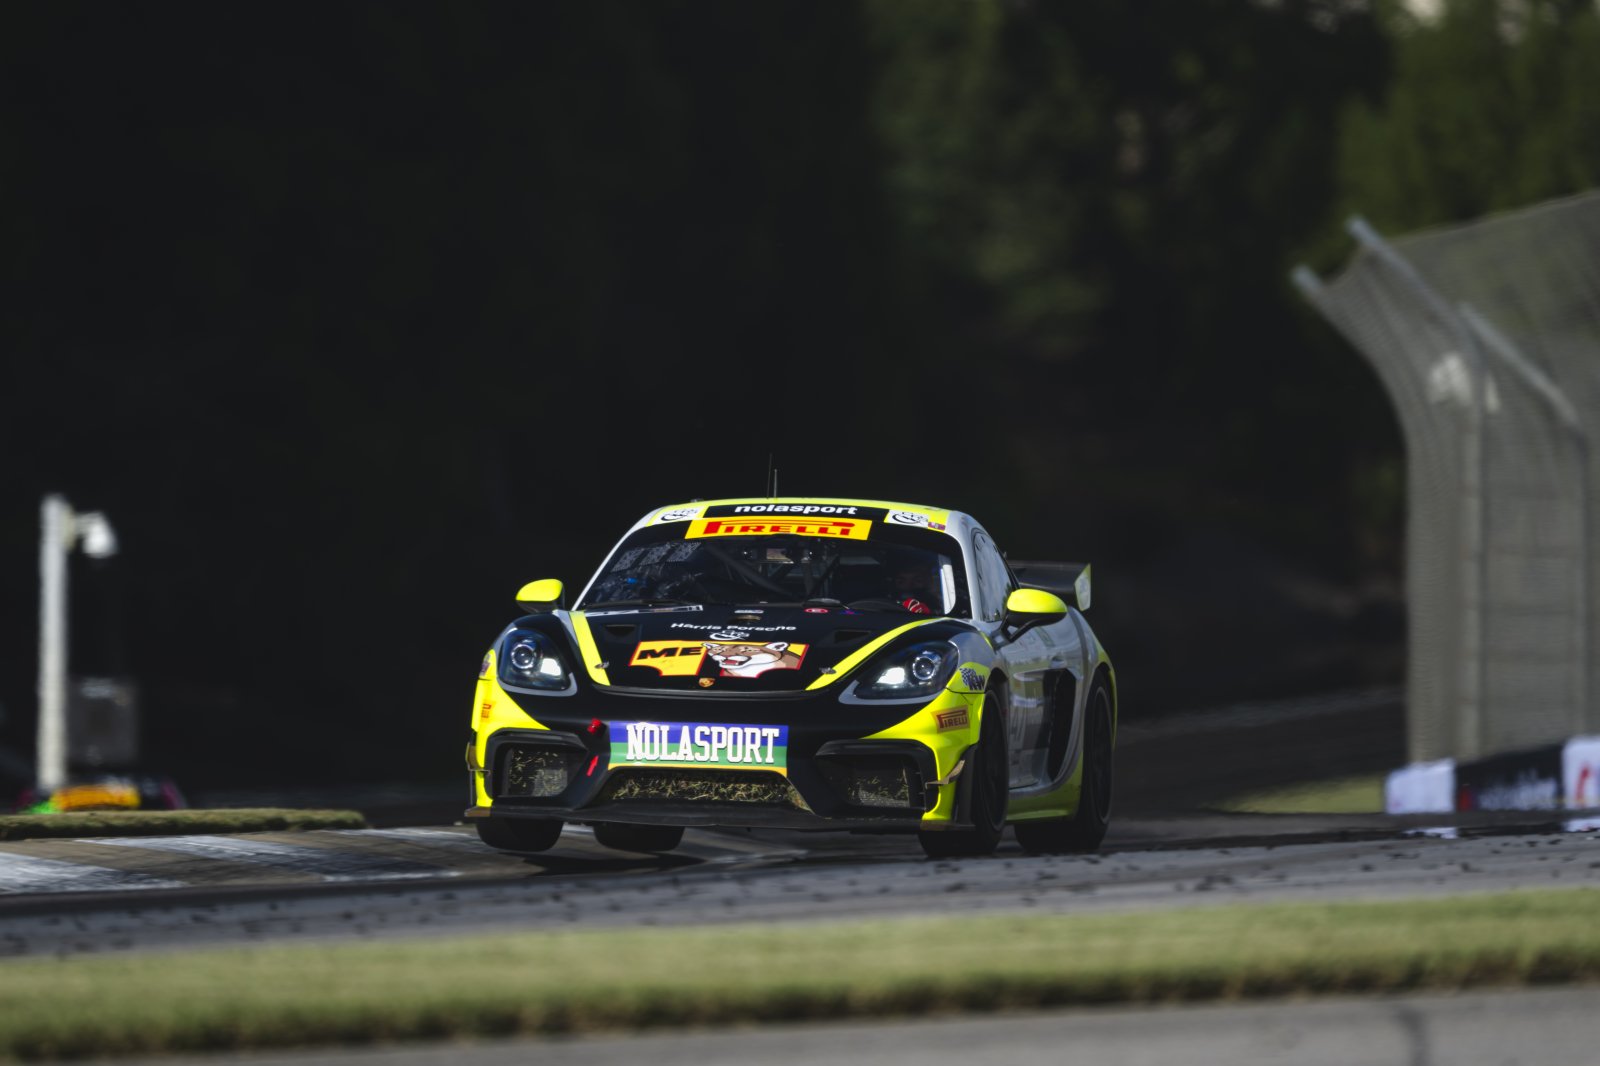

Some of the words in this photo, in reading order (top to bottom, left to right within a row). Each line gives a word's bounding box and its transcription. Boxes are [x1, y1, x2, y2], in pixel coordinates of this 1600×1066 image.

[734, 503, 858, 515] nolasport
[702, 520, 855, 536] PIRELLI
[637, 647, 703, 660] ME
[936, 709, 968, 729] PIRELLI
[626, 722, 780, 764] NOLASPORT
